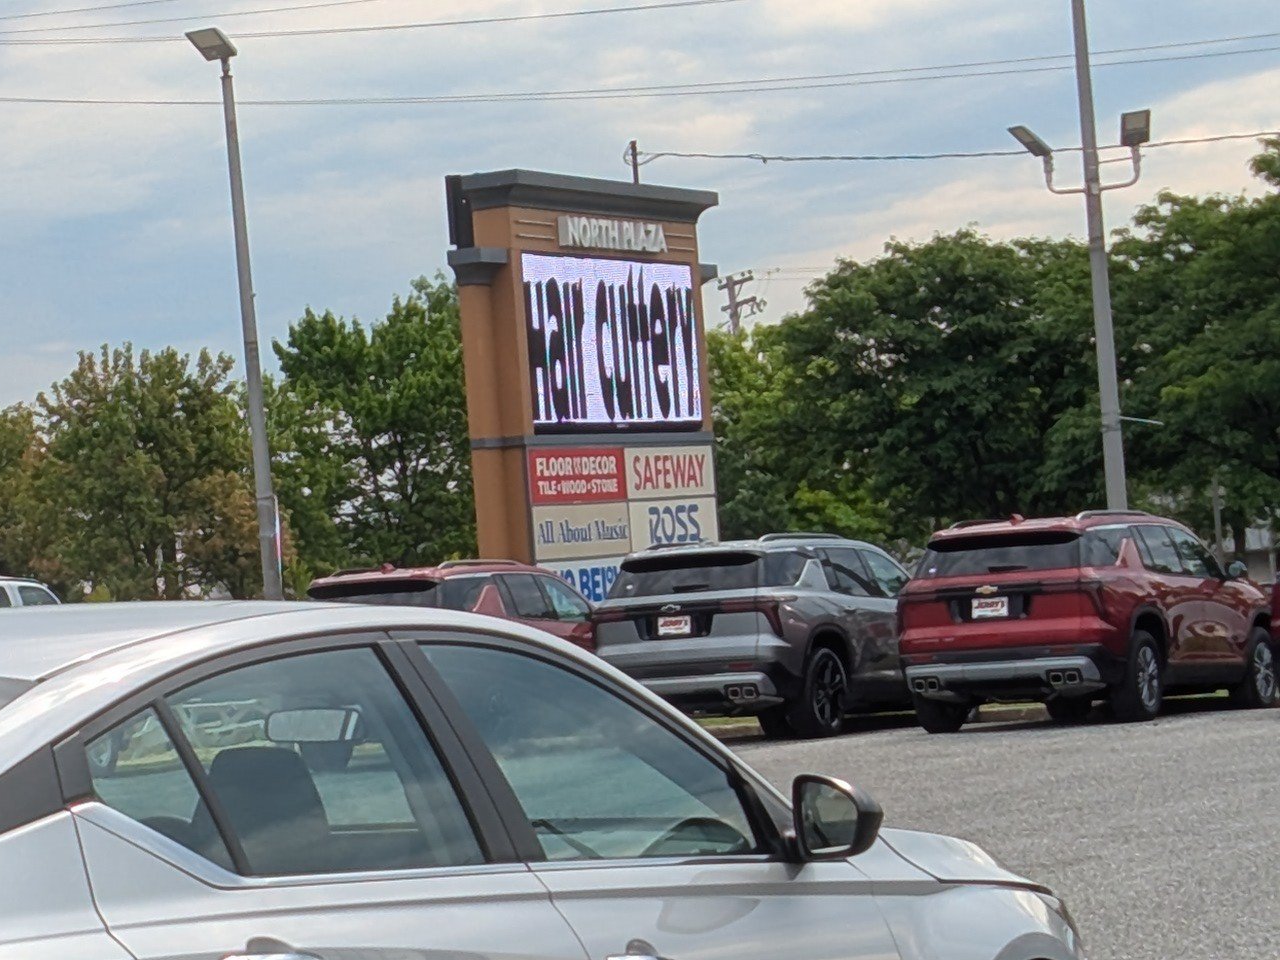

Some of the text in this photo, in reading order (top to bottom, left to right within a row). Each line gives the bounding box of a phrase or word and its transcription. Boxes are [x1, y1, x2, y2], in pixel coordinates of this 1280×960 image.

[560, 215, 669, 254] NORTH PLAZA
[523, 277, 588, 424] Hair
[535, 456, 573, 477] FLOOR
[581, 455, 617, 475] DECOR
[632, 453, 706, 491] SAFEWAY
[537, 478, 619, 495] TILE WOOD STONE
[538, 518, 628, 544] All About Music
[648, 503, 701, 545] ROSS
